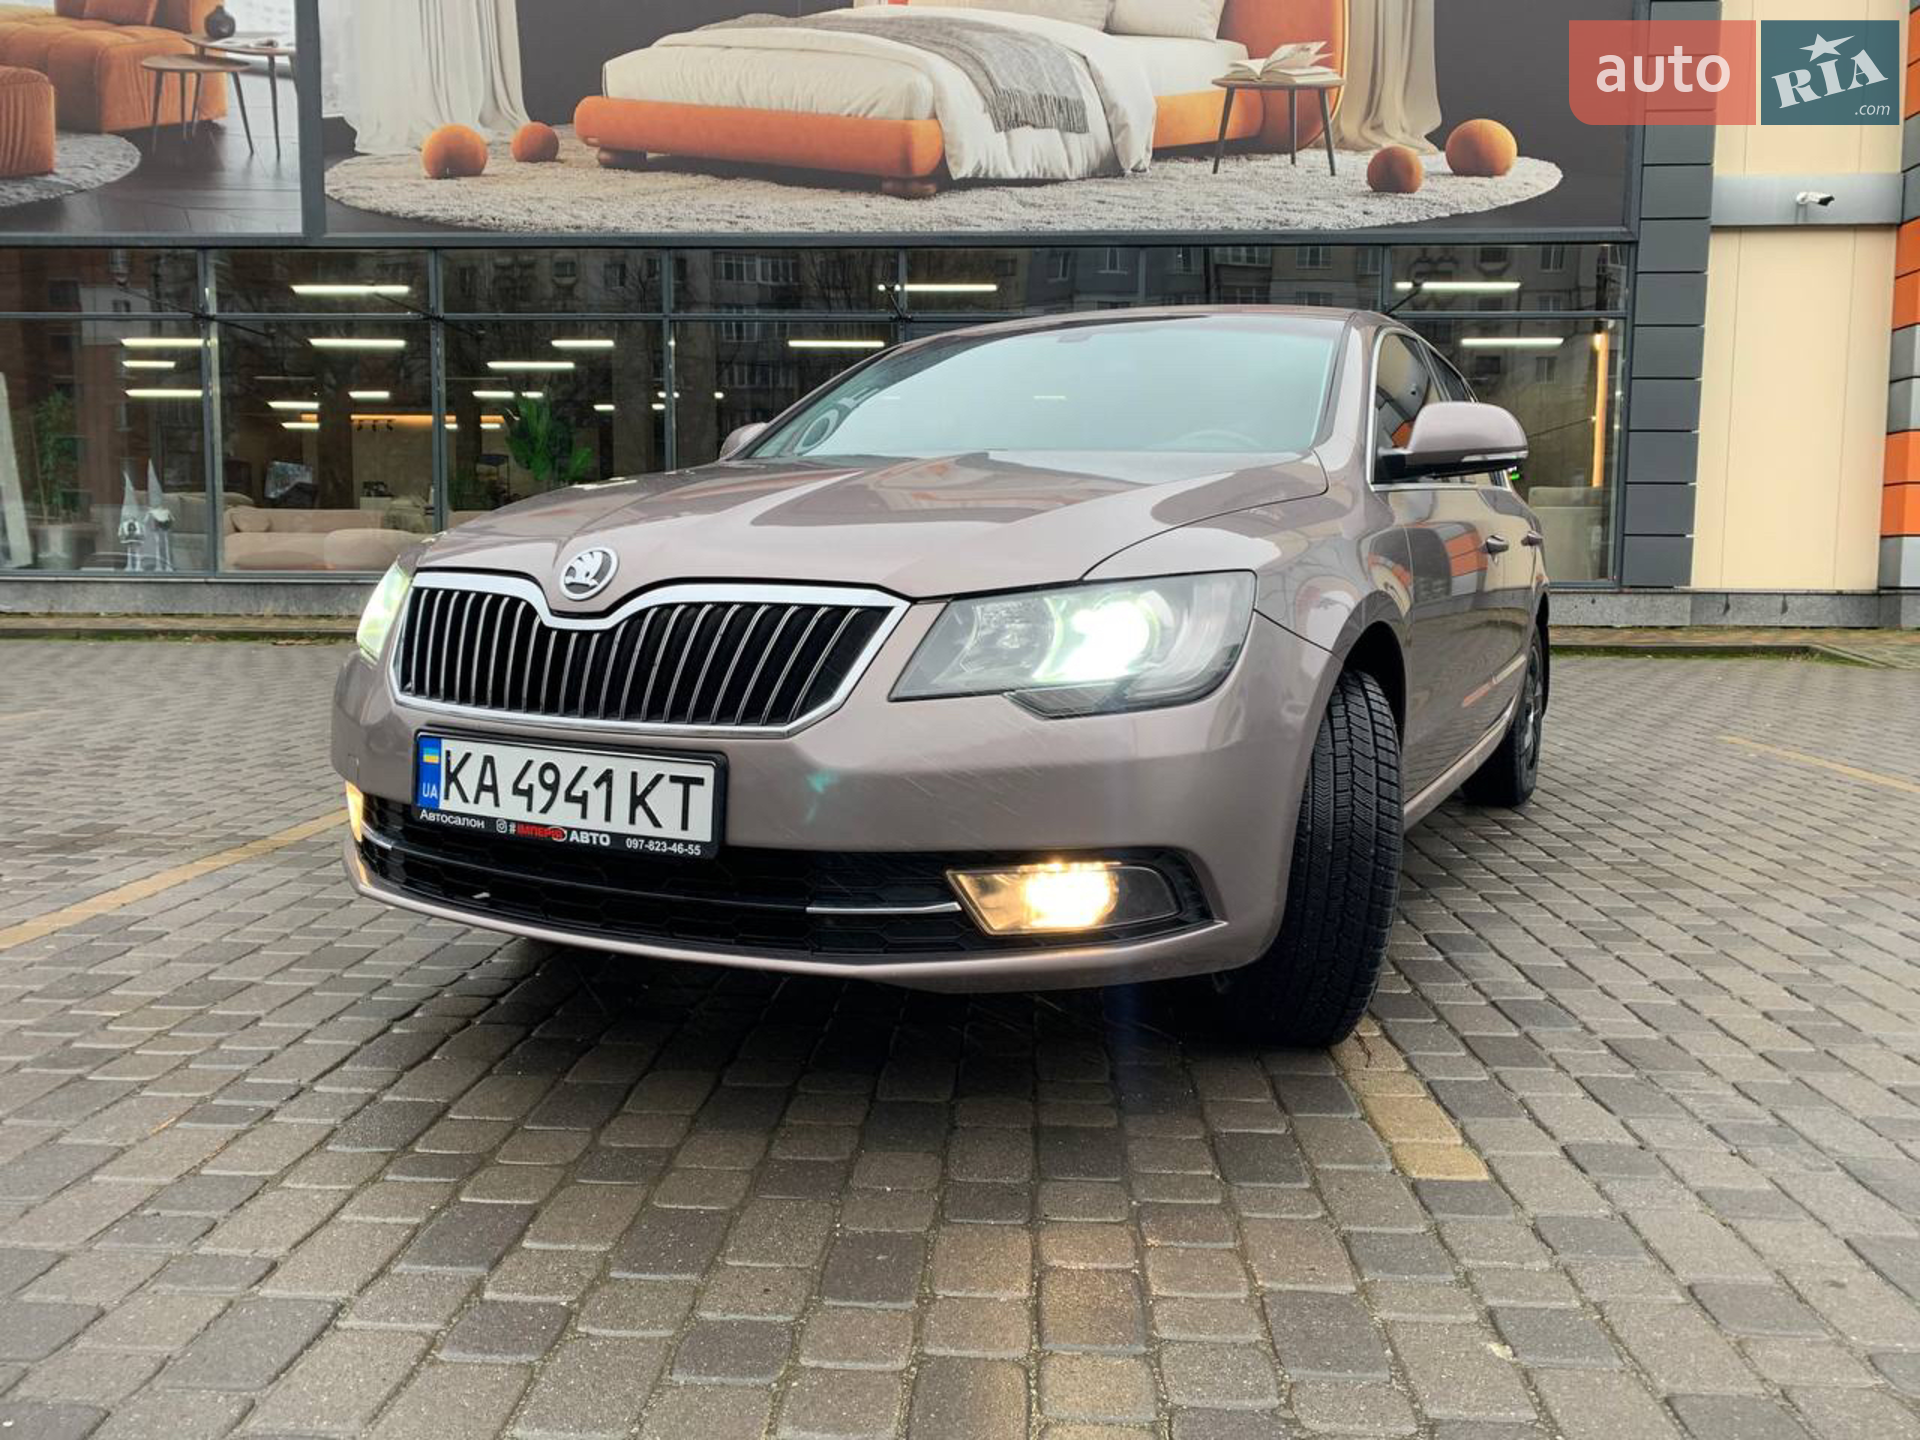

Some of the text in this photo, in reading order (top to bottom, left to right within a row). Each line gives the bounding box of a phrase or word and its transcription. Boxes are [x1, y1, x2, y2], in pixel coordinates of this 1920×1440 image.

[422, 782, 438, 799] UA
[420, 808, 485, 829] Автосалон
[626, 837, 701, 856] 097-823-46-55
